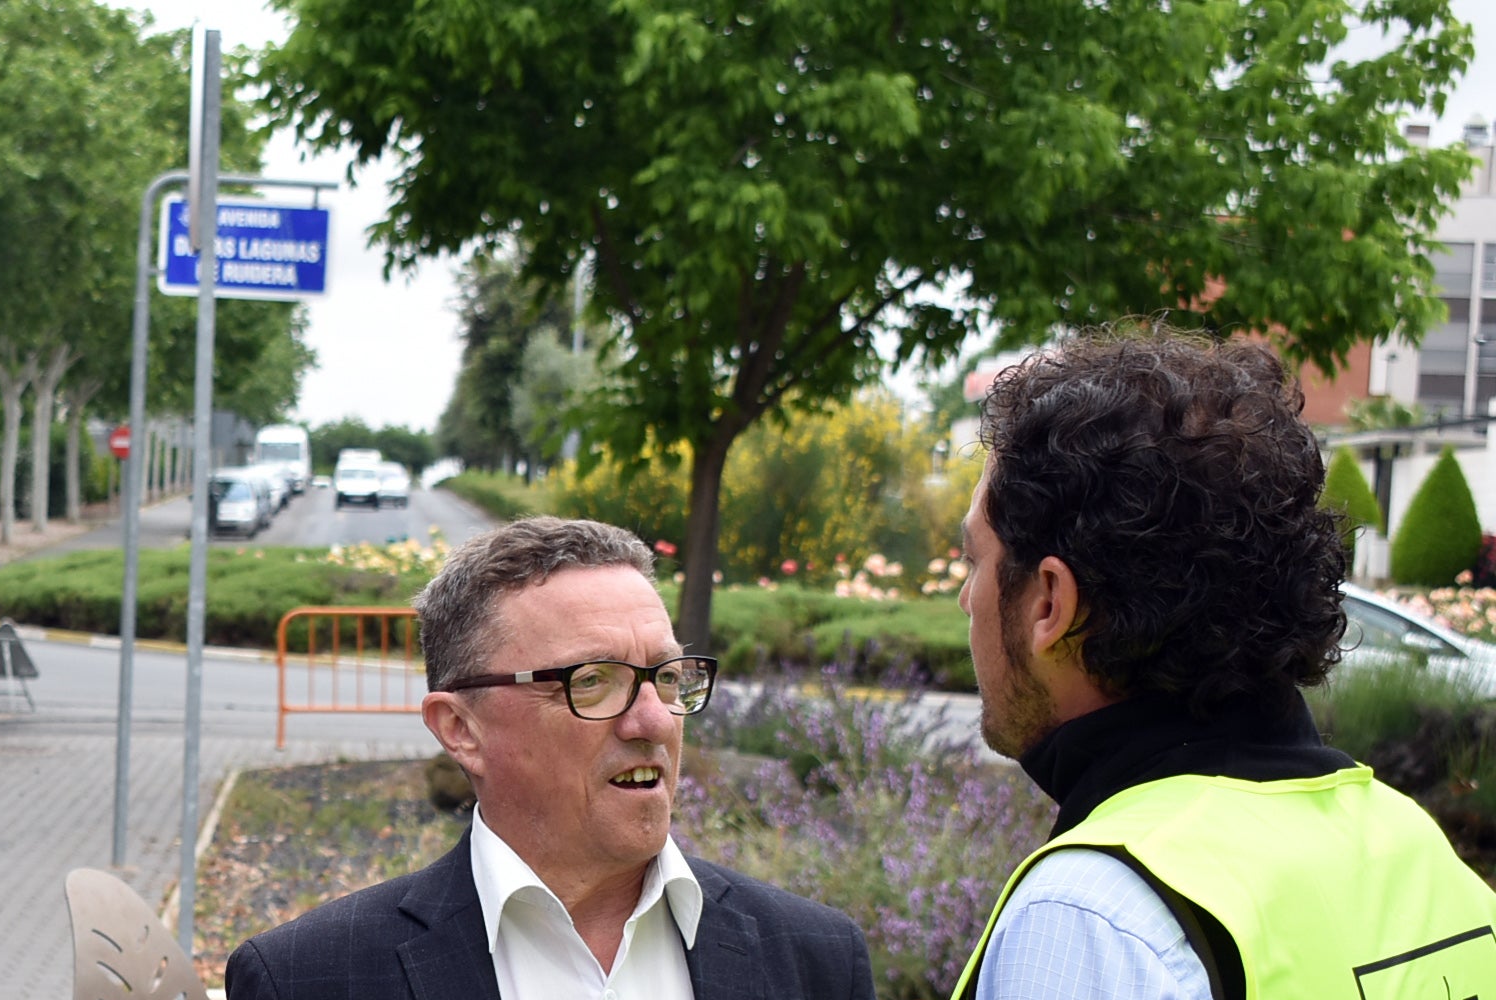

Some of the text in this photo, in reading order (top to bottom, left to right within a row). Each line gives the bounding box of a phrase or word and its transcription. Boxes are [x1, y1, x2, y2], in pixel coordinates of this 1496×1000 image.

[218, 209, 280, 228] AVENIDA
[213, 236, 236, 259] AS
[239, 238, 321, 263] LAGUNAS
[221, 262, 297, 287] RUIDERA
